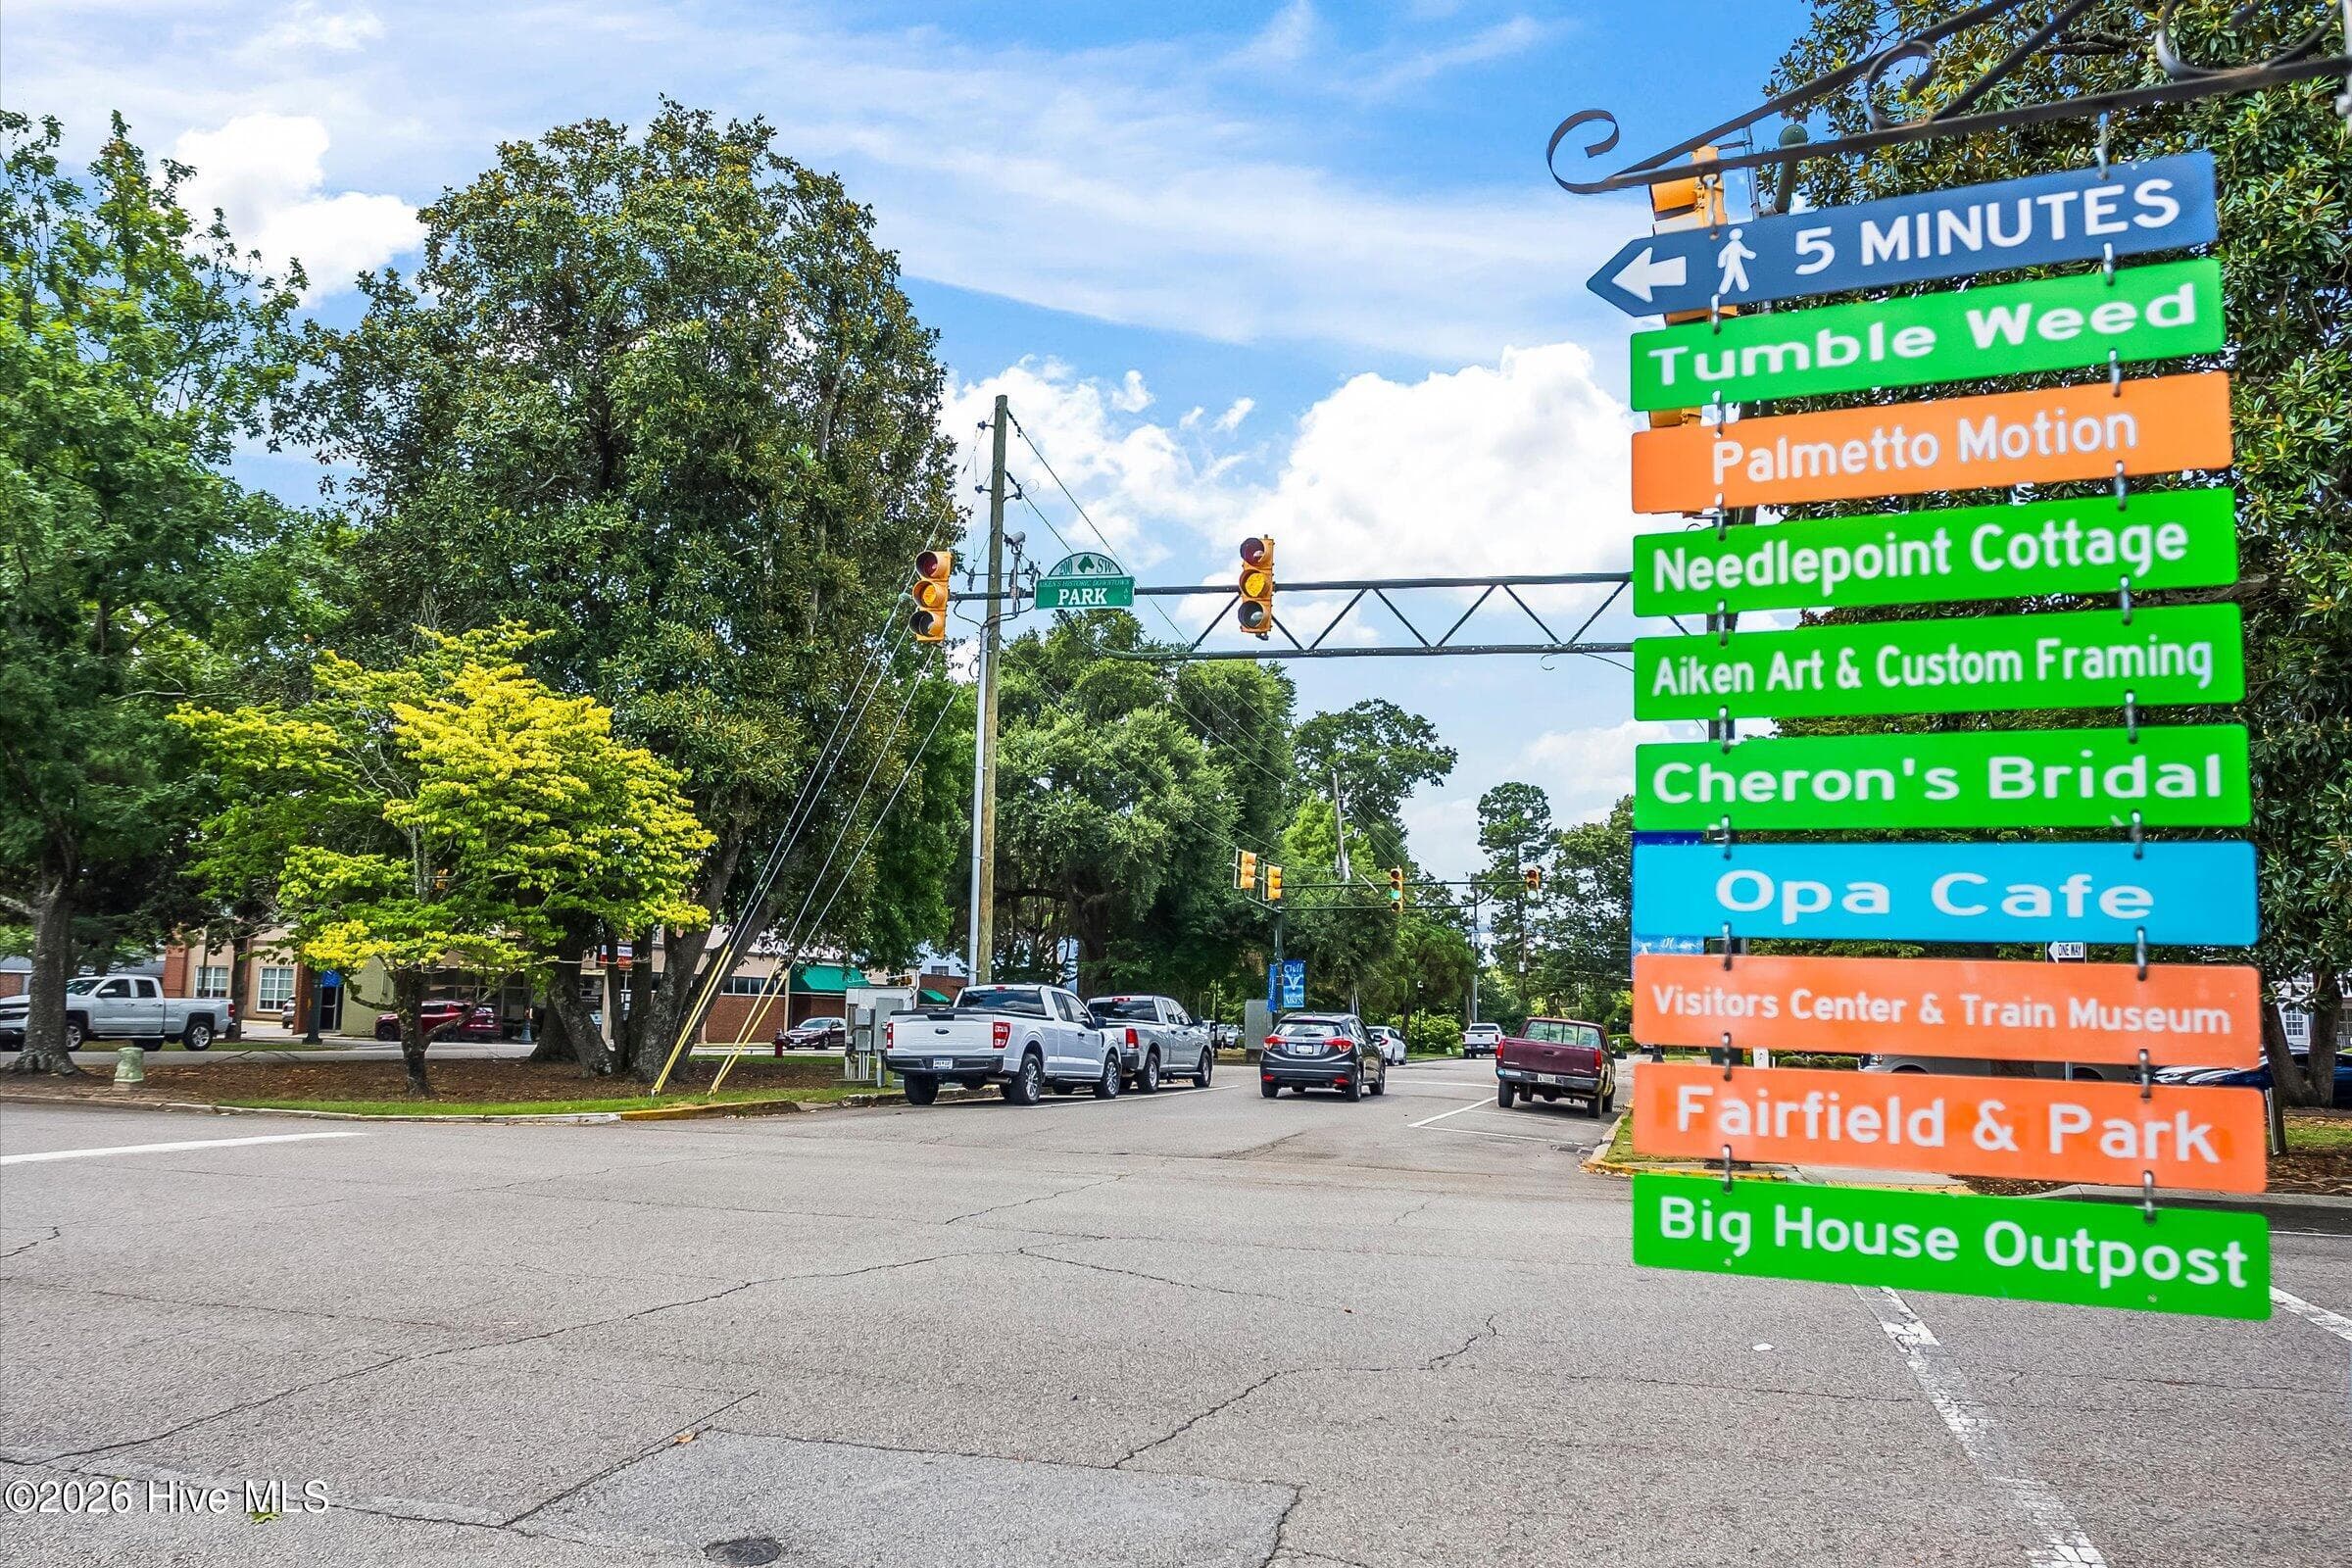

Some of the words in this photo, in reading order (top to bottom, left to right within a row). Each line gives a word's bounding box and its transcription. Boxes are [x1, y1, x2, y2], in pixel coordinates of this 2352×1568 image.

[1795, 226, 1835, 274] 5
[1860, 179, 2180, 266] MINUTES
[1649, 322, 1936, 385] Tumble
[1966, 283, 2195, 349] Weed
[1713, 425, 1941, 485] Palmetto
[1957, 408, 2138, 464] Motion
[1059, 559, 1073, 574] 200
[1097, 558, 1113, 573] SW
[1651, 528, 1950, 596] Needlepoint
[1972, 520, 2186, 576] Cottage
[1058, 588, 1107, 606] PARK
[1653, 658, 1753, 695] Aiken
[1767, 651, 1823, 690] Art
[1838, 648, 1861, 688] &
[1878, 645, 2022, 686] Custom
[2037, 639, 2211, 687] Framing
[1654, 759, 1958, 803] Cheron's
[1989, 751, 2220, 799] Bridal
[1717, 870, 1888, 924] Opa
[1933, 873, 2152, 918] Cafe
[2059, 944, 2069, 956] ONE
[2071, 943, 2082, 956] WAY
[1652, 984, 1779, 1020] Visitors
[1789, 988, 1908, 1023] Center
[1919, 991, 1944, 1024] &
[1959, 992, 2057, 1028] Train
[2068, 996, 2231, 1034] Museum
[1677, 1085, 1944, 1148] Fairfield
[1972, 1099, 2018, 1152] &
[2049, 1103, 2220, 1163] Park
[1661, 1197, 1750, 1256] Big
[1776, 1205, 1958, 1260] House
[1985, 1221, 2246, 1288] Outpost
